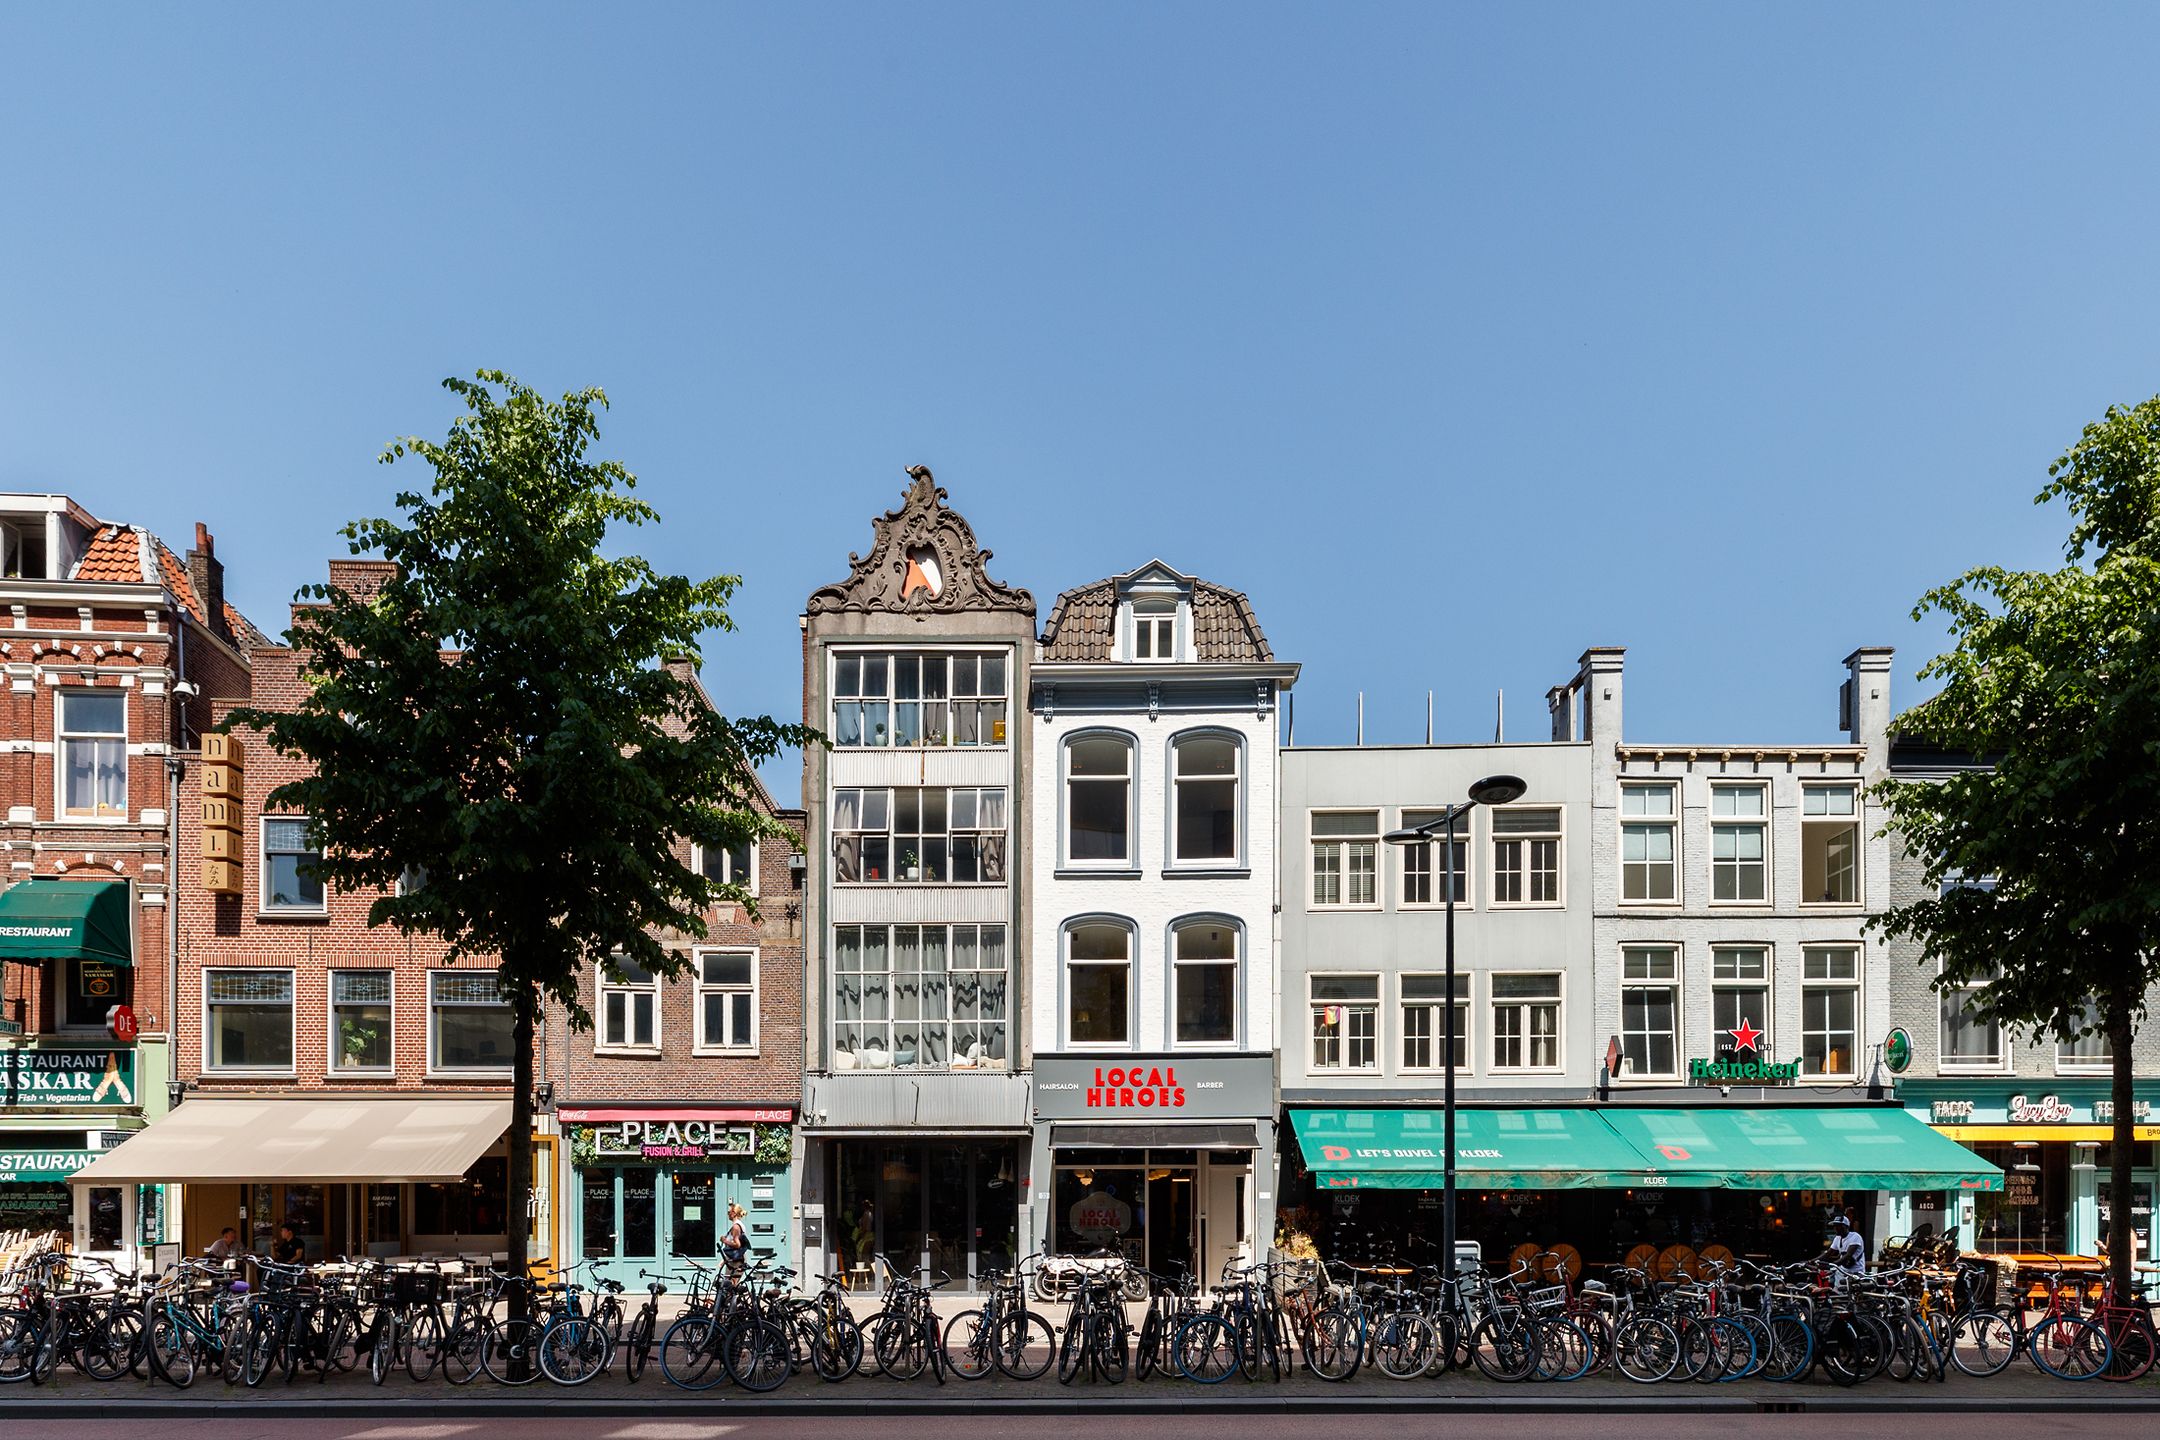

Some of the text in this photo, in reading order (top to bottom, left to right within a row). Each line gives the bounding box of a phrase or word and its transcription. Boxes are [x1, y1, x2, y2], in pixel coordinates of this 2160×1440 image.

[0, 1055, 107, 1068] ESTAURANT
[1691, 1057, 1803, 1078] Heineken
[1095, 1067, 1177, 1087] LOCAL
[1196, 1081, 1224, 1089] BARBER
[46, 1094, 91, 1103] Vegetarian
[1086, 1087, 1186, 1107] HEROES
[1933, 1101, 1975, 1117] TACOS
[754, 1110, 790, 1120] PLACE
[622, 1121, 727, 1145] PLACE
[644, 1146, 672, 1157] FUSION
[682, 1146, 705, 1157] GRILL
[1356, 1149, 1392, 1158] LET'S
[1393, 1149, 1437, 1158] DUVEL
[1458, 1149, 1503, 1158] KLOEK
[0, 1154, 104, 1170] STAURANT
[589, 1188, 609, 1196] PLACE
[681, 1186, 708, 1195] PLACE
[1082, 1209, 1117, 1217] LOCAL
